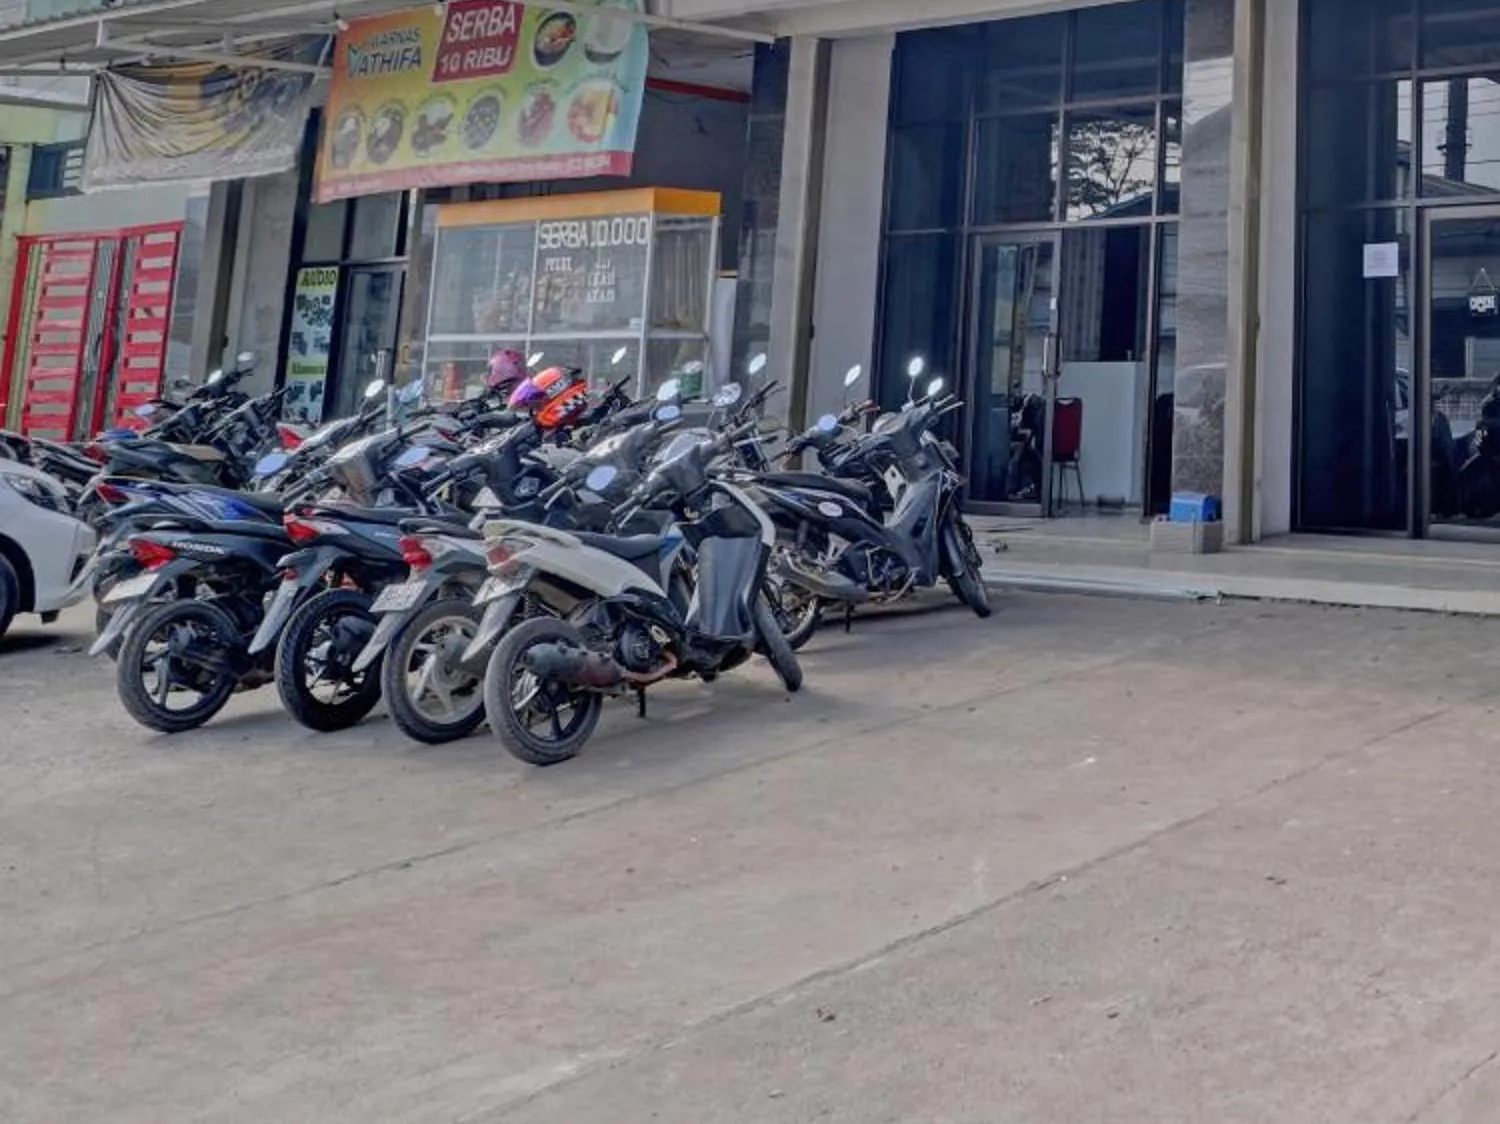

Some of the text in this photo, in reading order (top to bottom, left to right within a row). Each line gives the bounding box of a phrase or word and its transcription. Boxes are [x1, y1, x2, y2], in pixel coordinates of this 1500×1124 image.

[446, 4, 516, 43] SERBA
[440, 46, 512, 74] 10 RIBU
[541, 221, 588, 249] SERBA
[172, 540, 224, 555] HONDA
